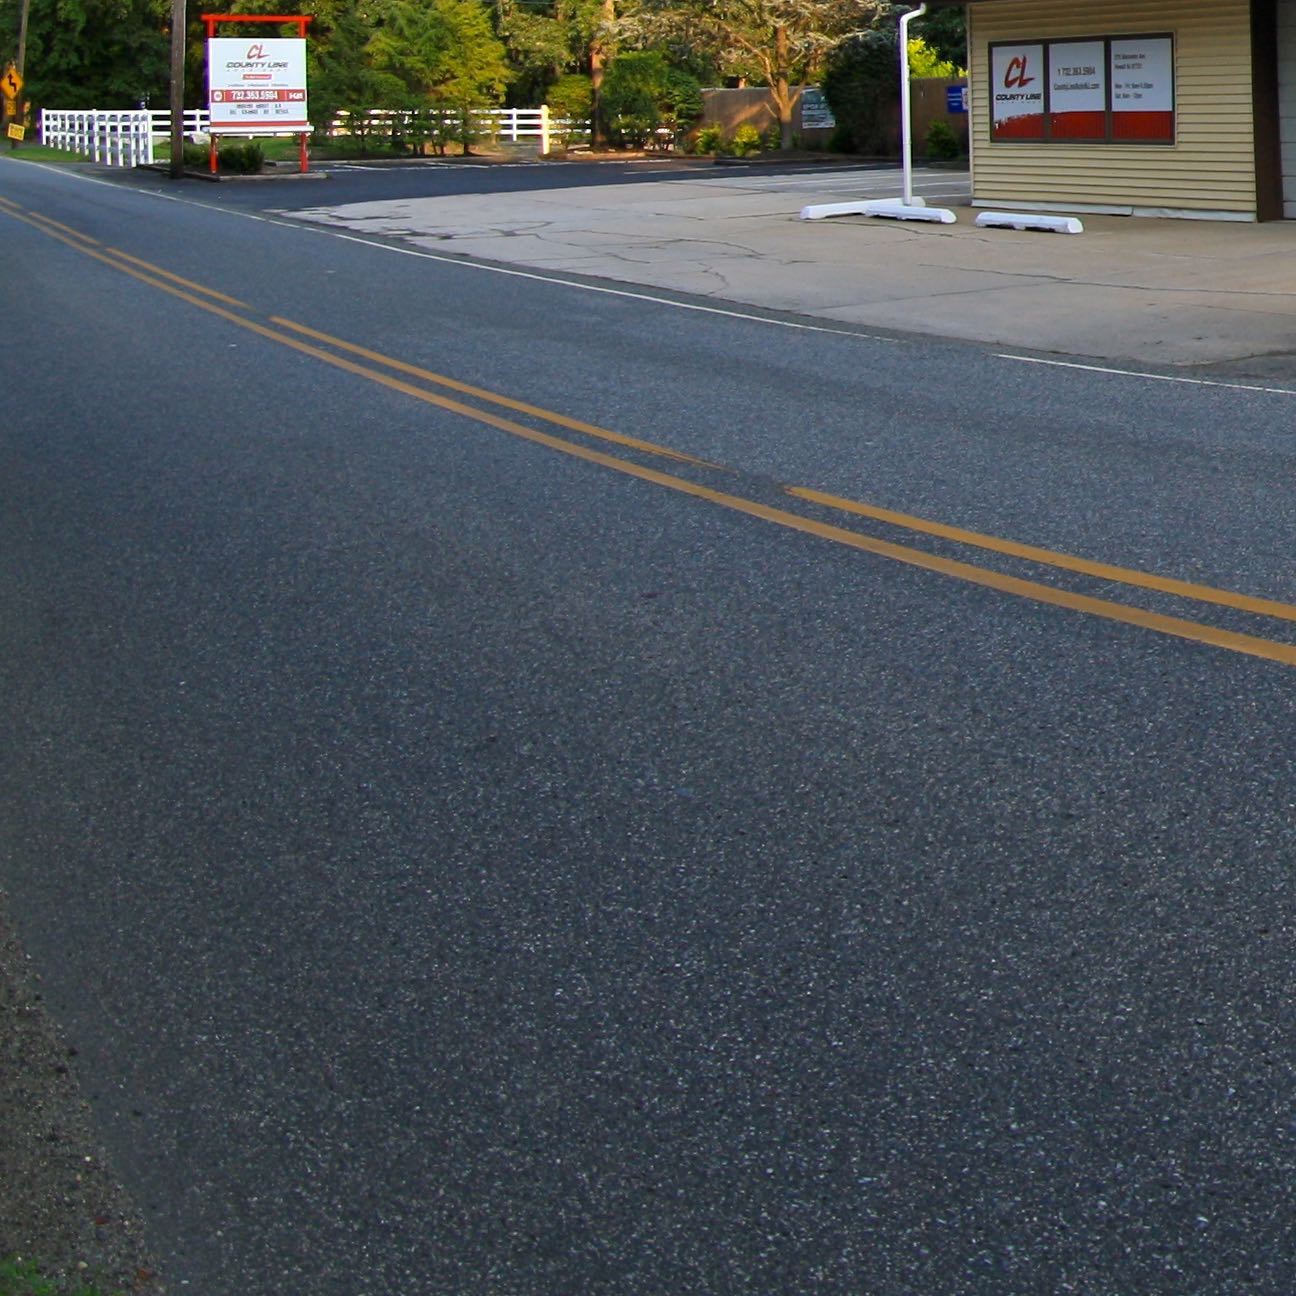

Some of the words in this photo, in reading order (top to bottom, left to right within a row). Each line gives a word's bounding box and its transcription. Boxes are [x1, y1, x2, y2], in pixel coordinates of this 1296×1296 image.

[246, 44, 271, 59] CL
[1004, 54, 1035, 88] CL
[995, 93, 1026, 101] COUNTY
